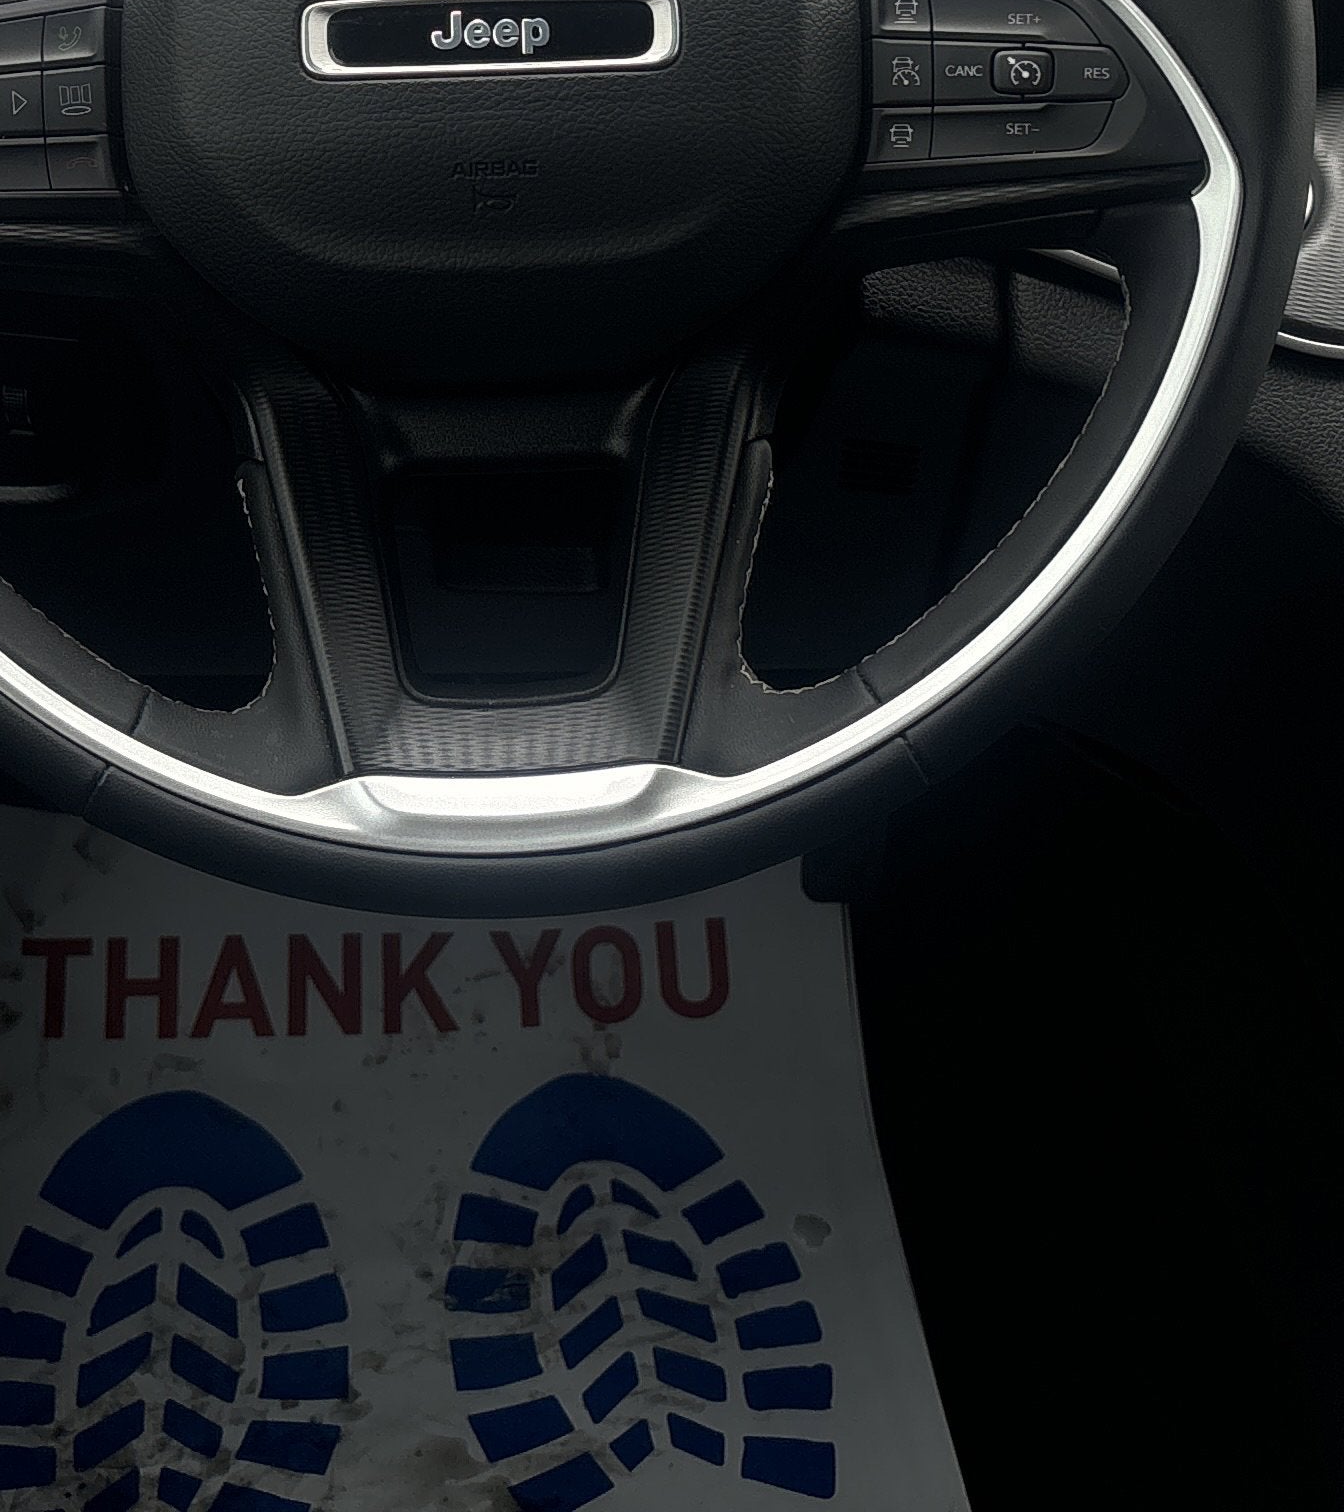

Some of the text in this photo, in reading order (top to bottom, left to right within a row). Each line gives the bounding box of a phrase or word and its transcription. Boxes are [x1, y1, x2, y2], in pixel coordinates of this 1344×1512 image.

[1007, 13, 1042, 26] SET+
[431, 10, 550, 54] Jeep
[945, 64, 983, 77] CANC
[1083, 67, 1110, 80] RES
[453, 160, 540, 179] AIRBAG
[21, 917, 731, 1040] THANK YOU
